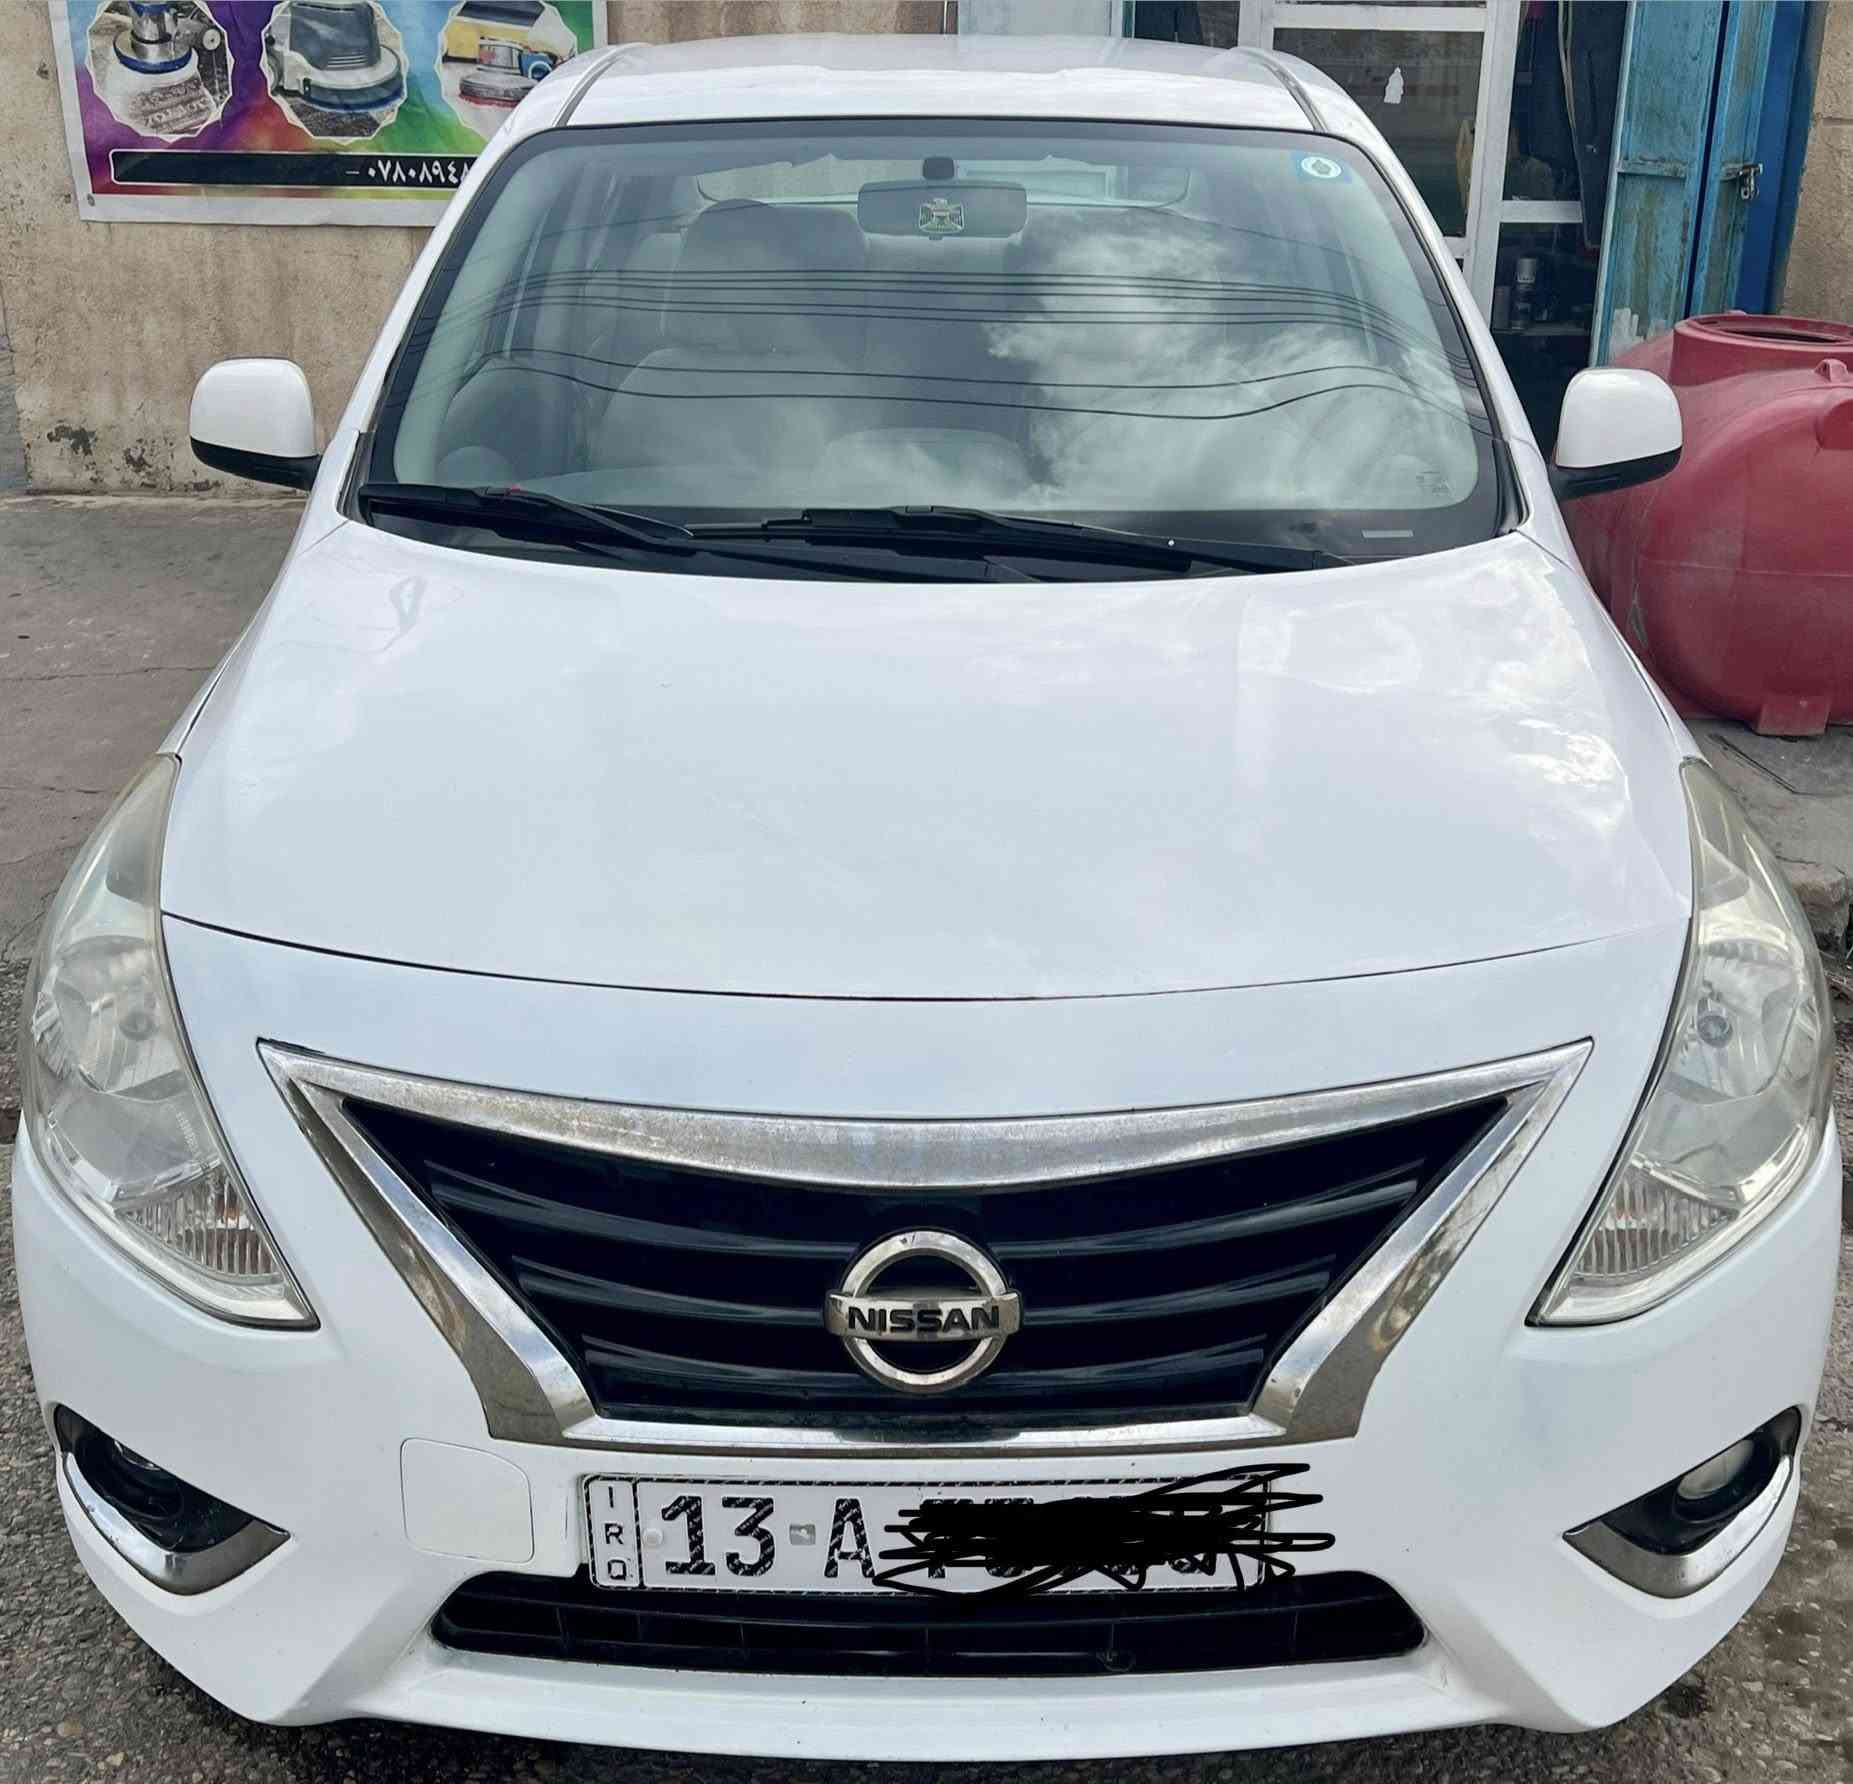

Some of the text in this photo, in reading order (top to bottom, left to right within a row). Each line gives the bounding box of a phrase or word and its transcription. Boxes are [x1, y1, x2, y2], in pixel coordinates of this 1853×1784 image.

[848, 1305, 1000, 1334] NISSAN
[604, 1486, 627, 1581] IRQ
[661, 1495, 776, 1577] 13
[824, 1497, 876, 1578] A
